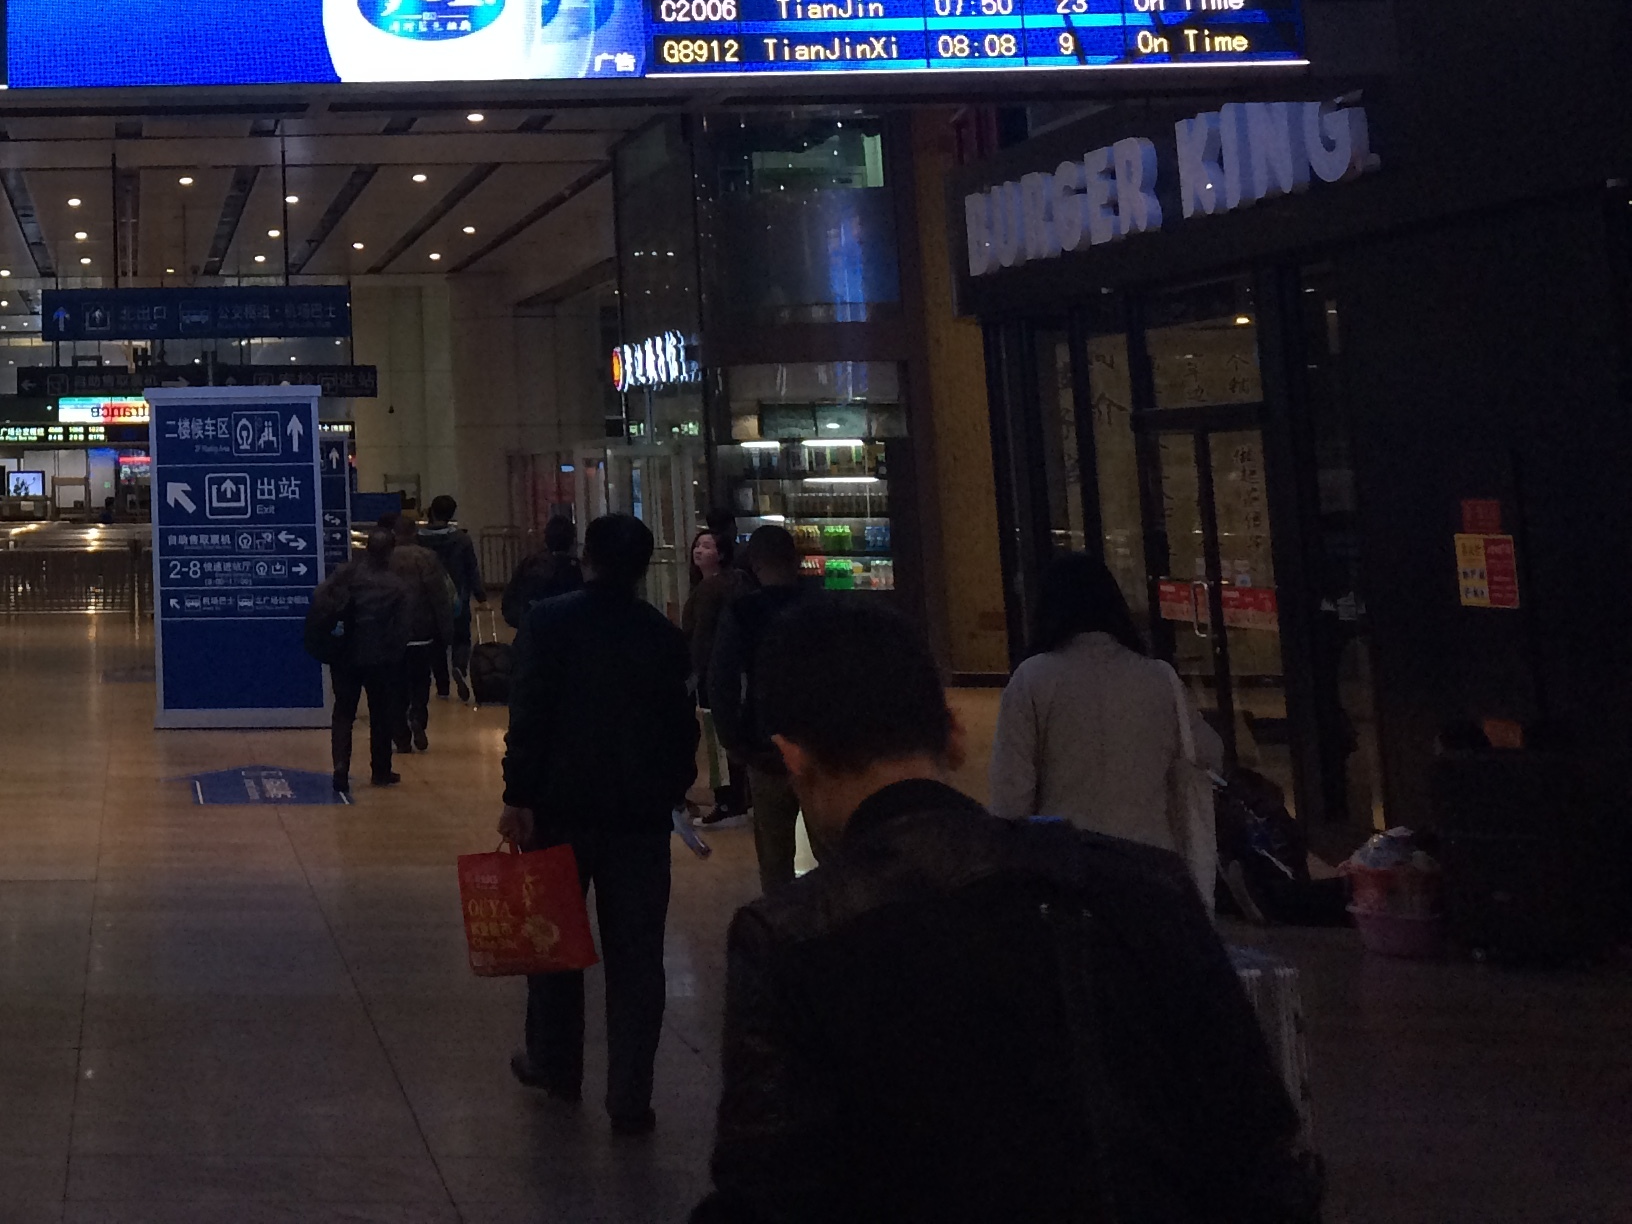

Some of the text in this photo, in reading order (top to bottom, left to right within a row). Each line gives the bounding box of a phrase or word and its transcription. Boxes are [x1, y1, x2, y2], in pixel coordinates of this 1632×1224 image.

[661, 0, 736, 21] C2006
[664, 32, 1248, 62] G8912 TianJinXi 08:08 9 On Time
[594, 52, 636, 72] 广告
[964, 136, 1160, 277] BURGER
[165, 417, 230, 440] 二楼候车区
[256, 477, 302, 500] 出站
[169, 560, 201, 579] 2-8
